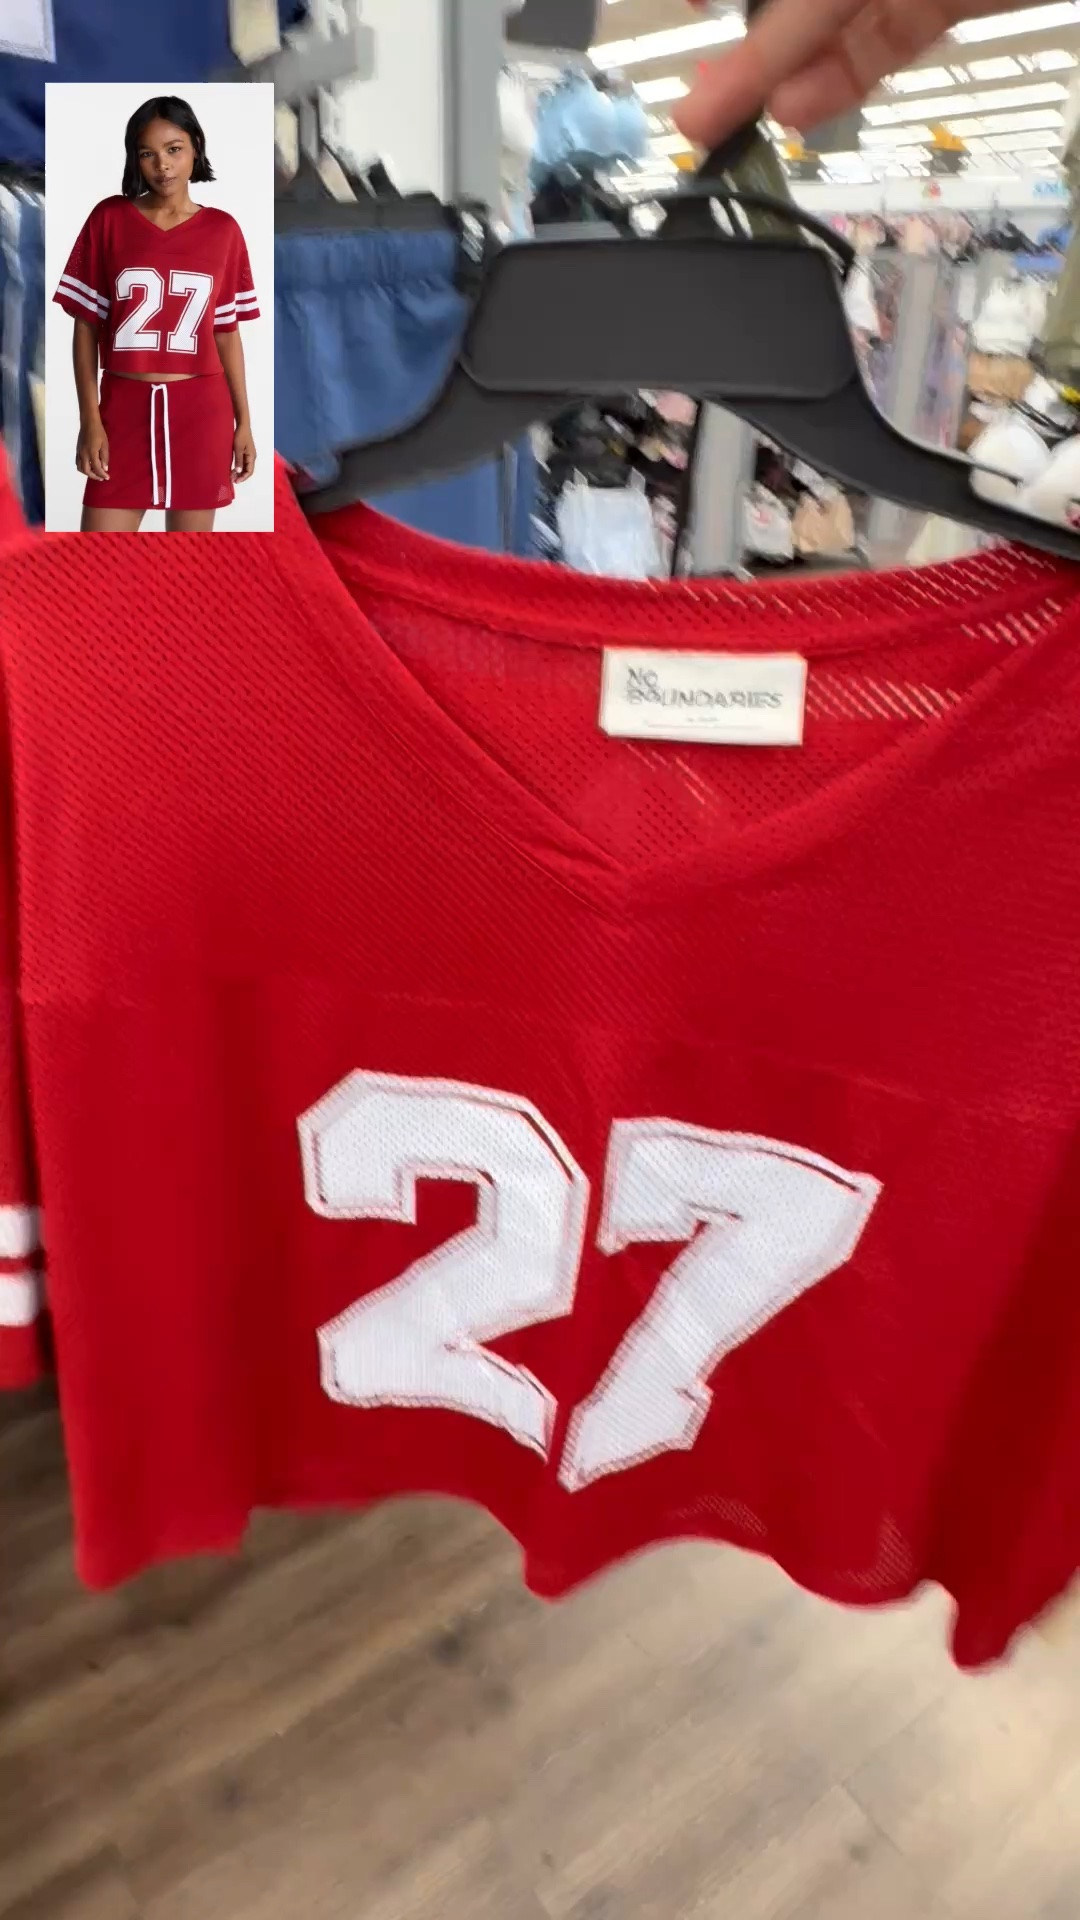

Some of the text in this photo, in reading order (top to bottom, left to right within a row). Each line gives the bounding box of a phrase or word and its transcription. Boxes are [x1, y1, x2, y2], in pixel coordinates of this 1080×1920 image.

[113, 267, 214, 354] 27
[626, 687, 784, 709] BOUNDARIES
[627, 667, 659, 688] NO
[297, 1068, 884, 1494] 27
